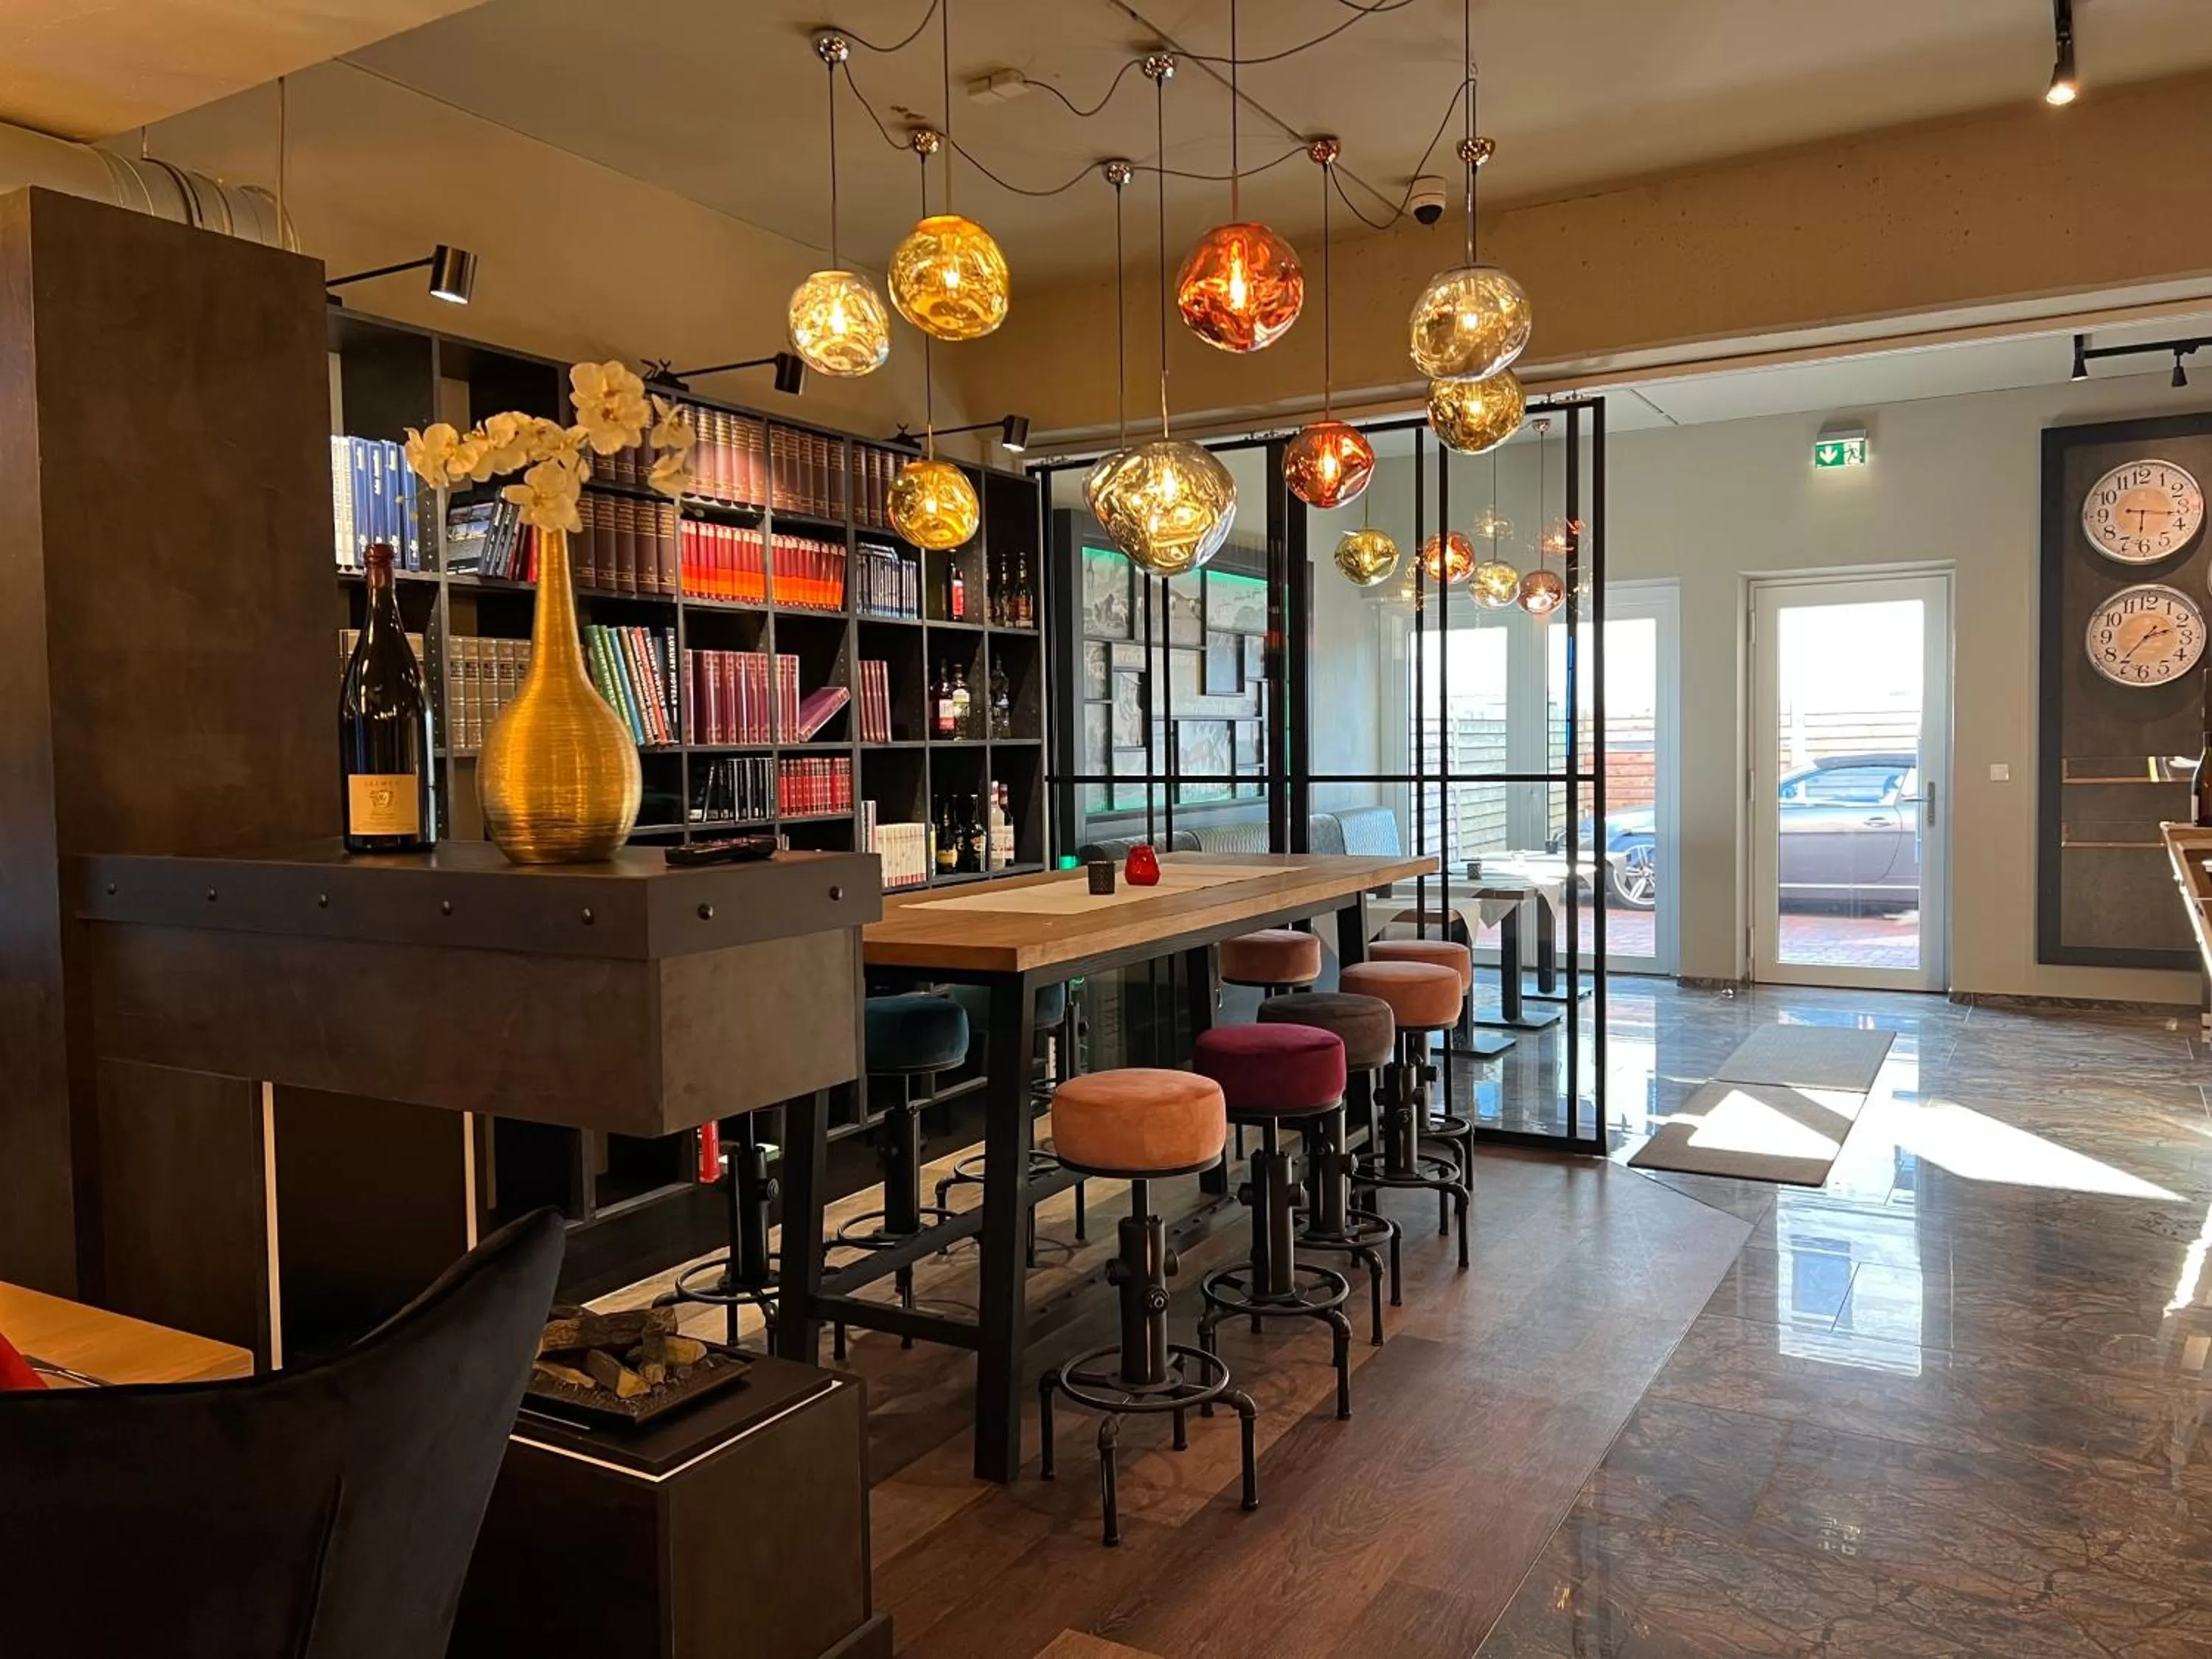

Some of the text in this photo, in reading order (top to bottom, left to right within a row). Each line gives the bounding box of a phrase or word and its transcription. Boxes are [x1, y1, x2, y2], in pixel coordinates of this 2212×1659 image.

[2118, 476, 2129, 490] 11
[2132, 469, 2151, 485] 12
[2160, 472, 2165, 487] 1
[2101, 489, 2117, 505] 10
[2171, 482, 2183, 498] 2
[2177, 498, 2189, 515] 3
[2097, 508, 2110, 524] 9
[2172, 517, 2186, 531] 4
[2104, 524, 2116, 540] 8
[2158, 532, 2170, 547] 5
[2120, 536, 2130, 552] 7
[2139, 538, 2151, 553] 6
[2124, 599, 2135, 613] 11
[2140, 594, 2158, 611] 12
[2166, 601, 2171, 615] 1
[2104, 611, 2122, 627] 10
[2176, 613, 2189, 627] 2
[2100, 629, 2112, 644] 9
[2179, 629, 2193, 645] 3
[667, 635, 676, 669] LUXURY
[2104, 647, 2117, 662] 8
[2173, 647, 2187, 661] 4
[646, 638, 665, 707] LUXURY HOTELS
[2120, 659, 2131, 675] 7
[2138, 664, 2150, 679] 6
[2157, 660, 2170, 675] 5
[669, 672, 678, 705] HOTELS
